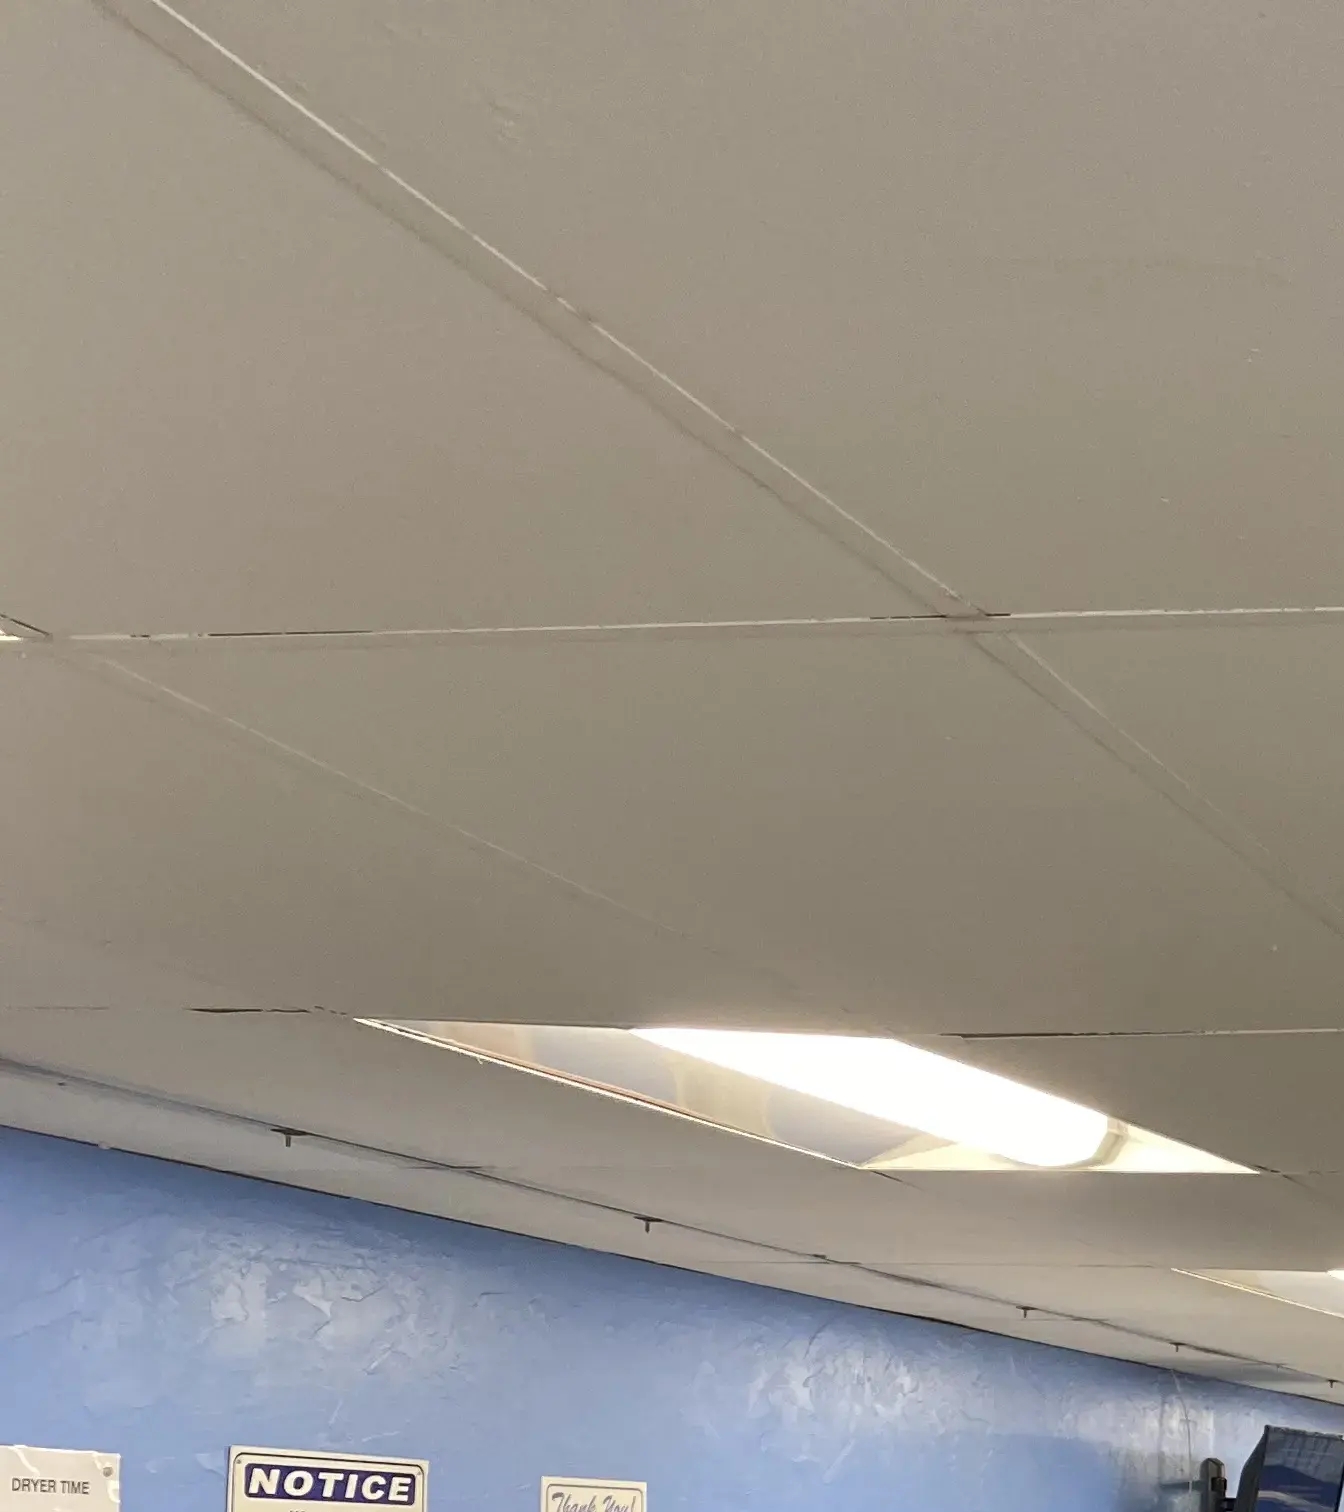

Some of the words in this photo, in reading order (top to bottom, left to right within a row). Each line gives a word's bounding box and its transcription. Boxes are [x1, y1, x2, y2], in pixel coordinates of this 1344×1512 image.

[11, 1477, 56, 1494] DRYER
[60, 1480, 90, 1495] TIME
[249, 1467, 413, 1502] NOTICE
